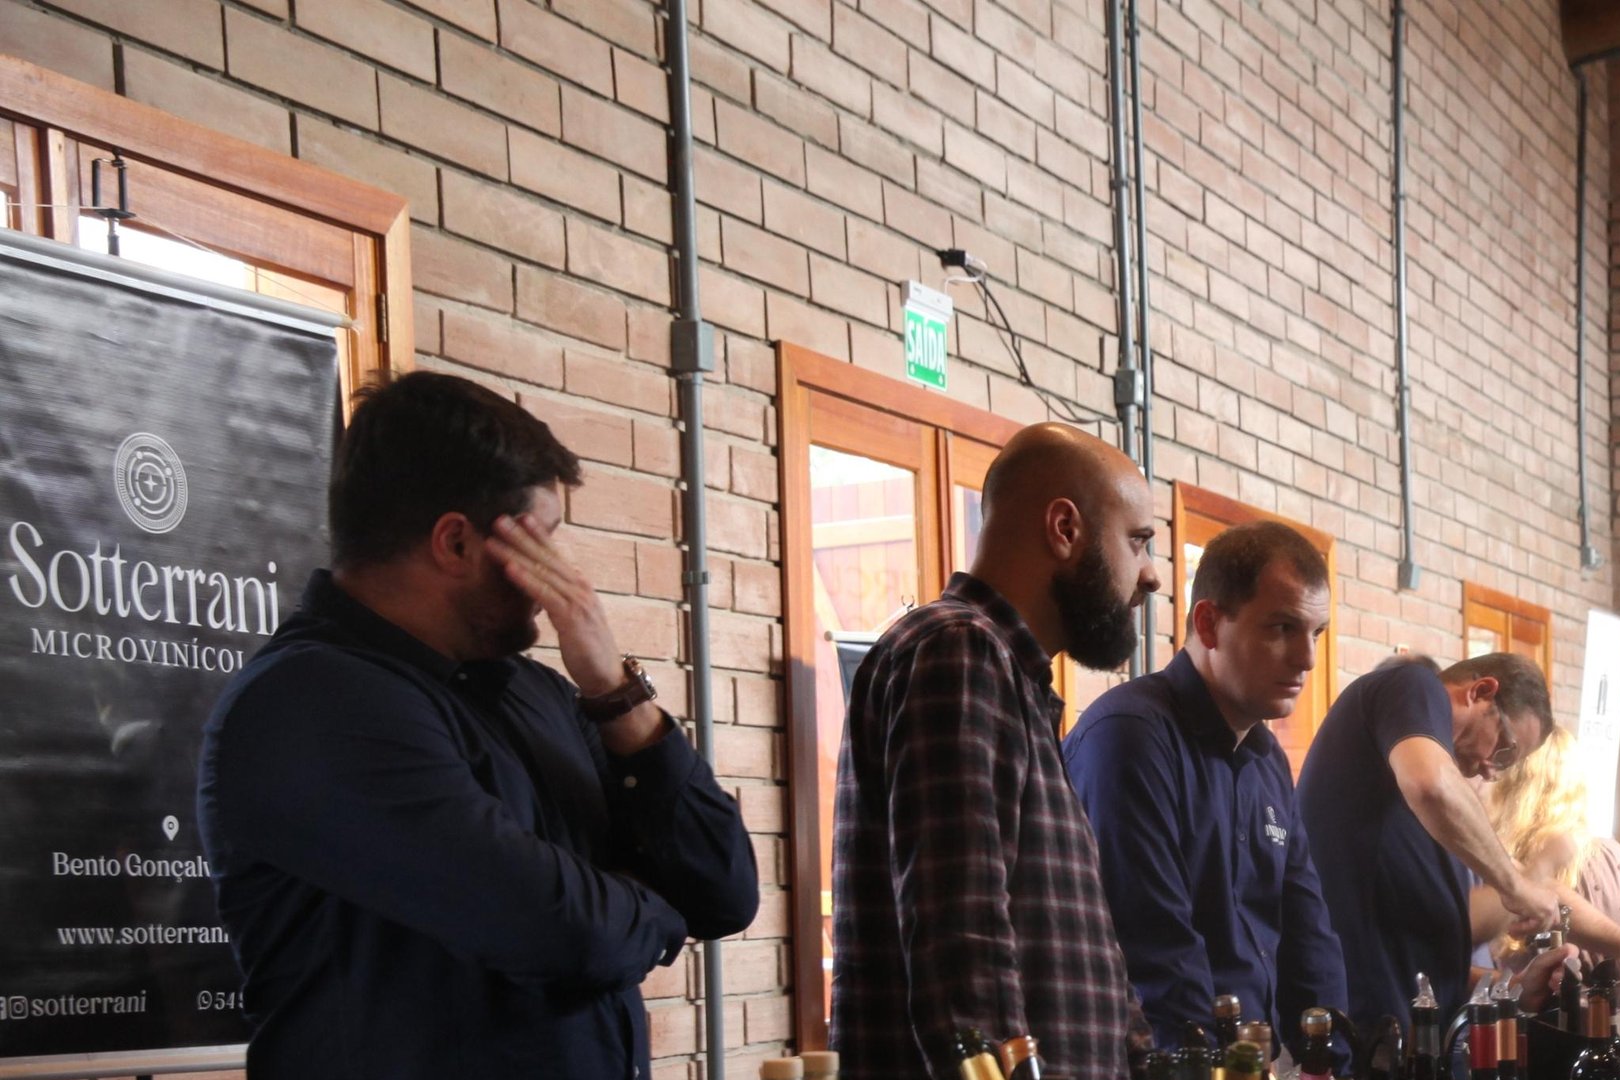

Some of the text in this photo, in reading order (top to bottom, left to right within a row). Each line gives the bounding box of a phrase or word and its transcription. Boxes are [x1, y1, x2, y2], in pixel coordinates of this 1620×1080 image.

[9, 521, 279, 636] Sotterrani
[53, 852, 121, 876] Bento
[32, 990, 146, 1016] sotterrani
